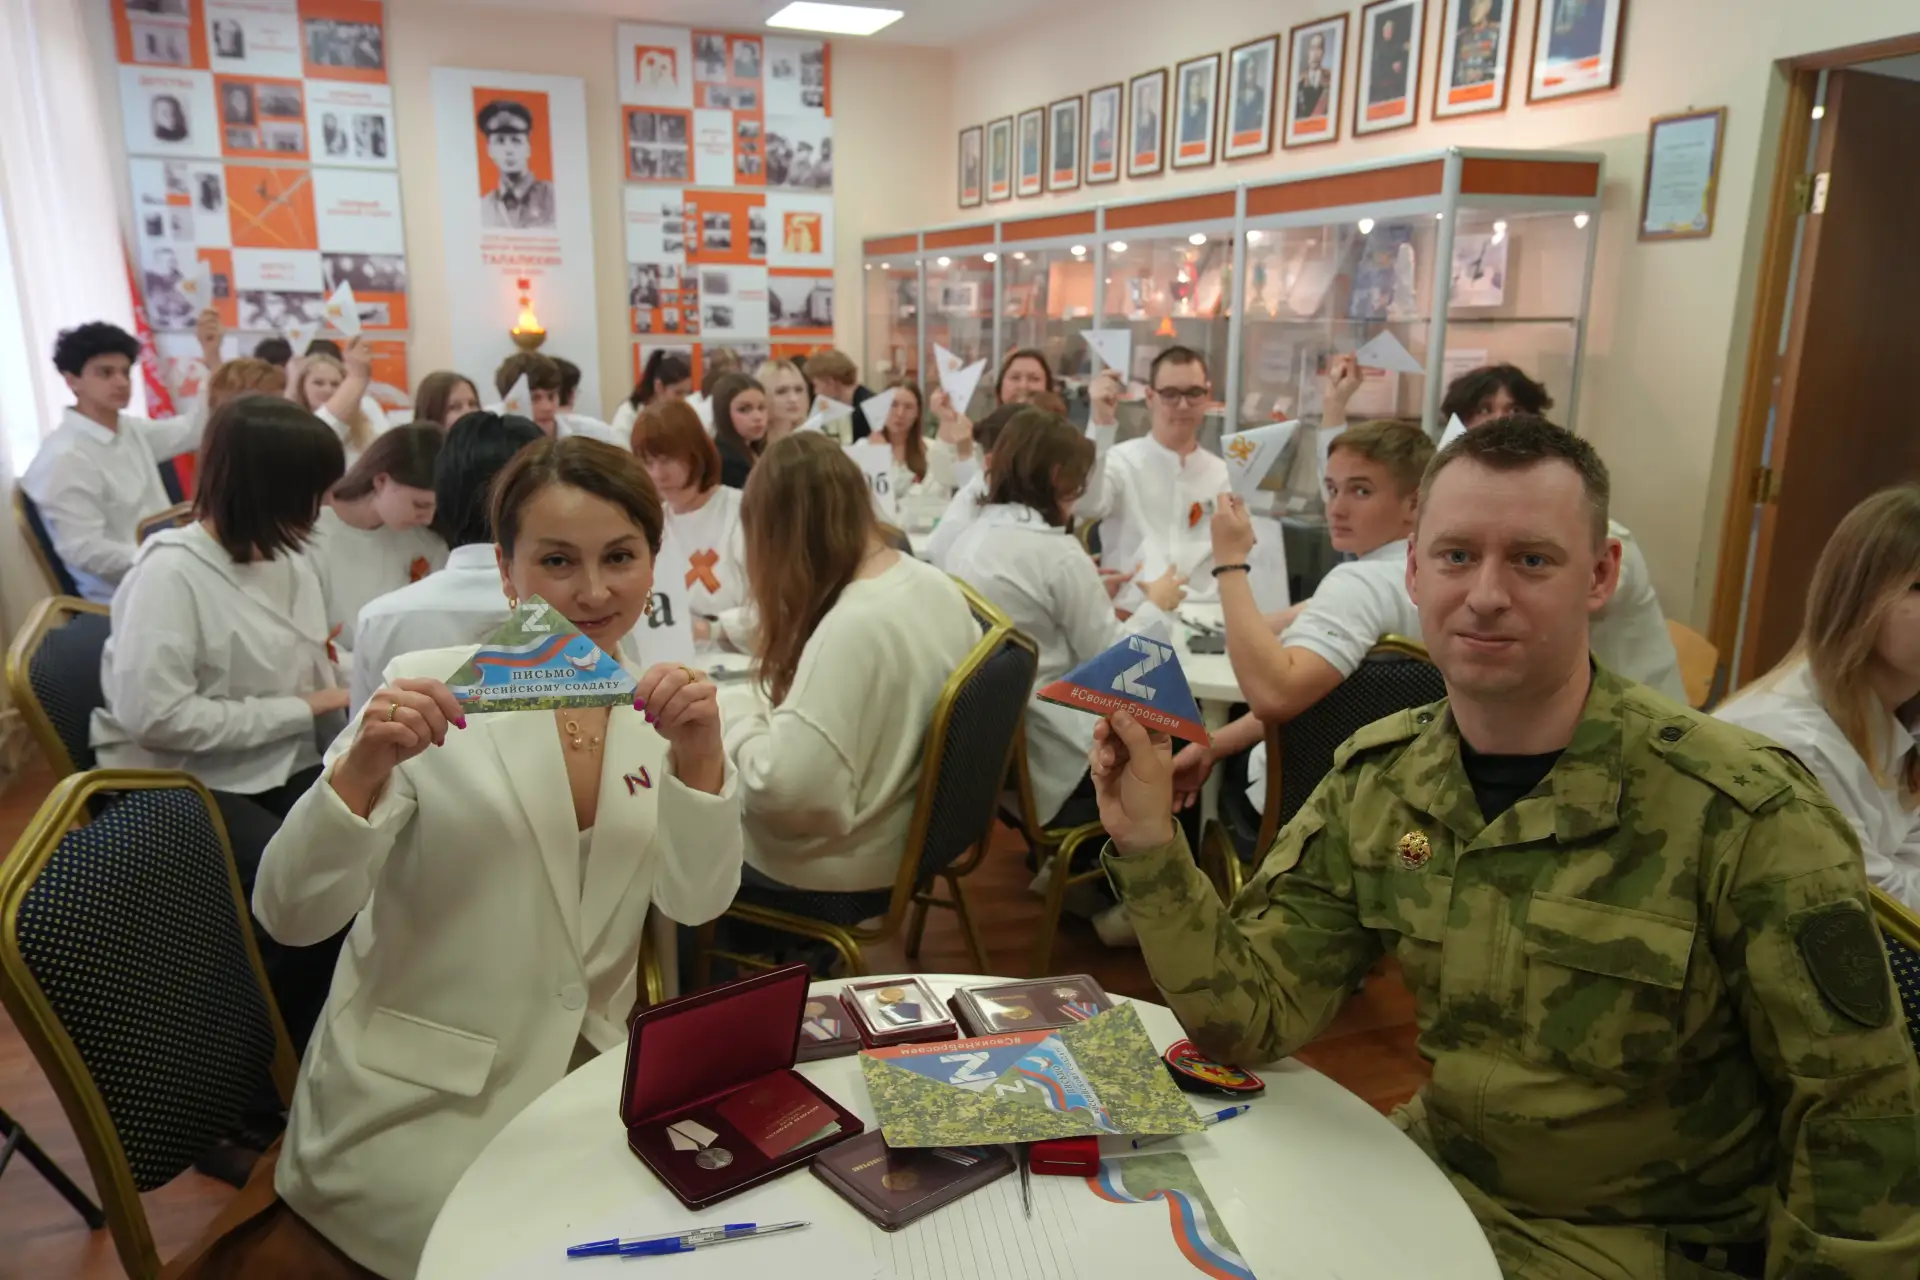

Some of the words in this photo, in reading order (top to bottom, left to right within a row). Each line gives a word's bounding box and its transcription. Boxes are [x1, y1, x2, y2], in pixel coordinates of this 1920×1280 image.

[521, 603, 551, 632] Z
[512, 668, 576, 680] ПИСЬМО
[1111, 636, 1173, 701] Z
[468, 683, 561, 696] РОССИЙСКОМУ
[565, 681, 620, 691] СОЛДАТУ
[1070, 687, 1180, 729] #СвоихНеБросаем
[900, 1037, 1021, 1055] #СвоихНеБросаем
[939, 1051, 997, 1084] Z
[1052, 1065, 1076, 1094] ПИСЬМО
